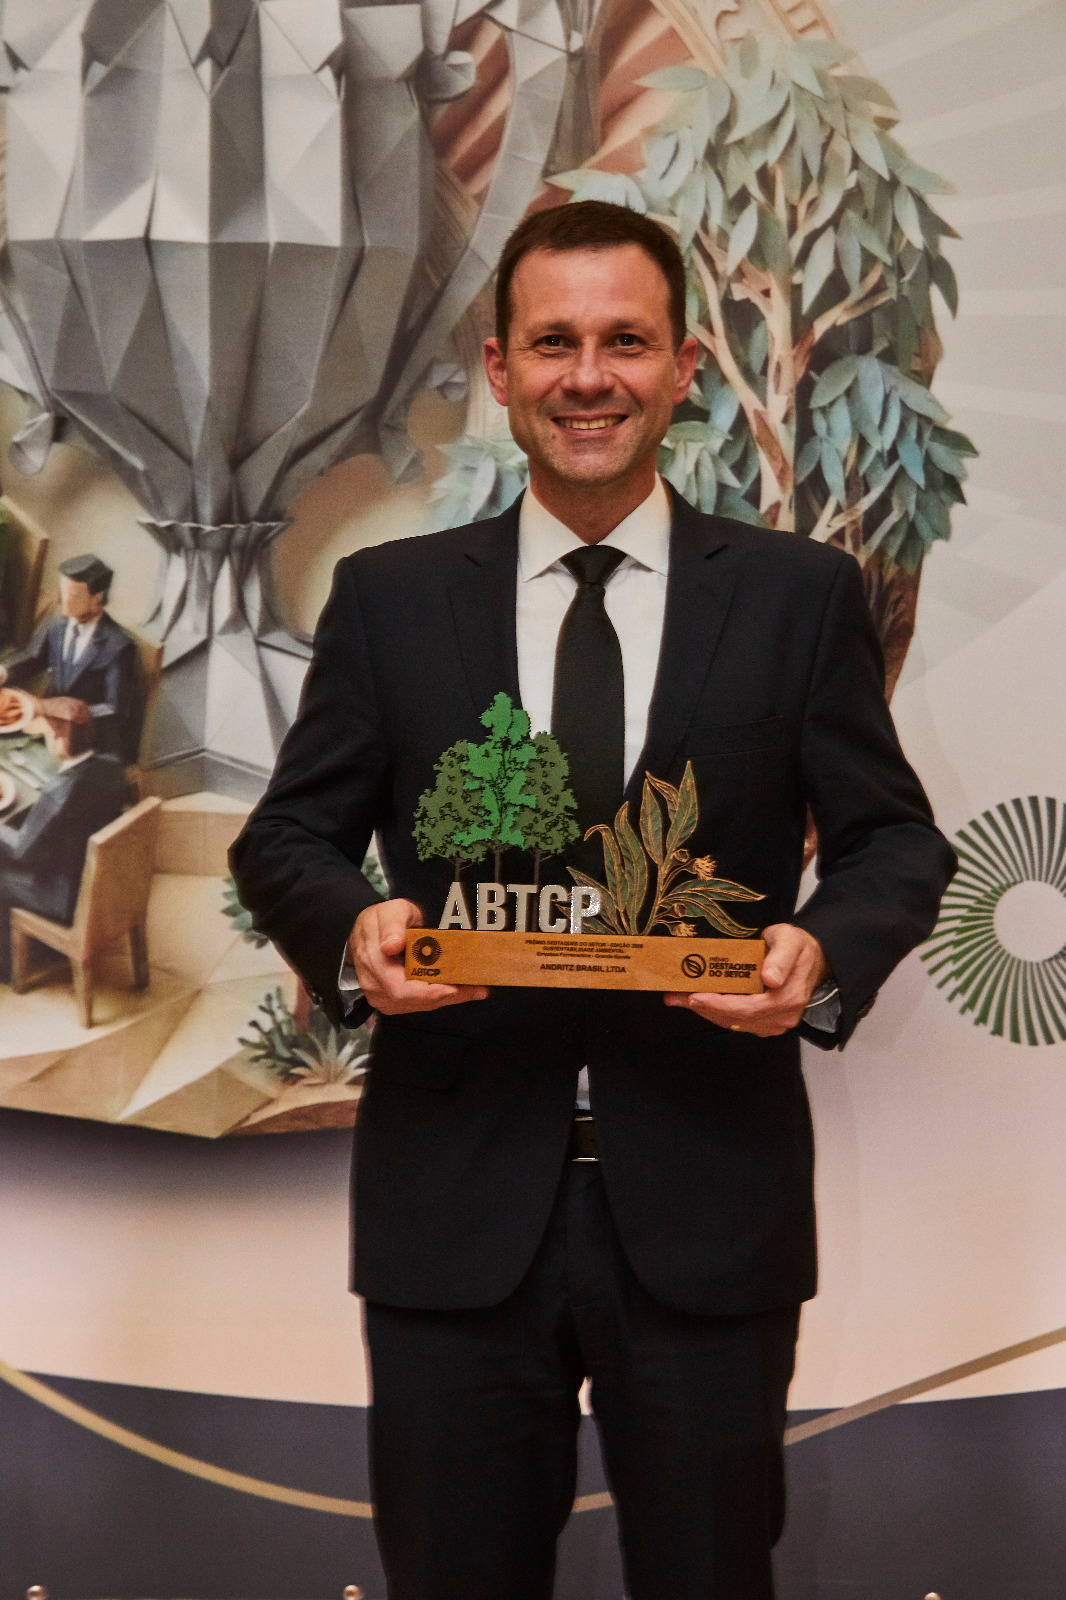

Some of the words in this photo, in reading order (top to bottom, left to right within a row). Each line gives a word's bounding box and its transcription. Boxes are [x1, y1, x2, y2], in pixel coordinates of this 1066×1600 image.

[437, 881, 601, 934] ABTCP
[540, 963, 574, 971] ANDRITZ
[576, 965, 604, 973] BRASIL
[708, 962, 757, 971] DESTAQUES
[411, 967, 440, 977] ABTCP
